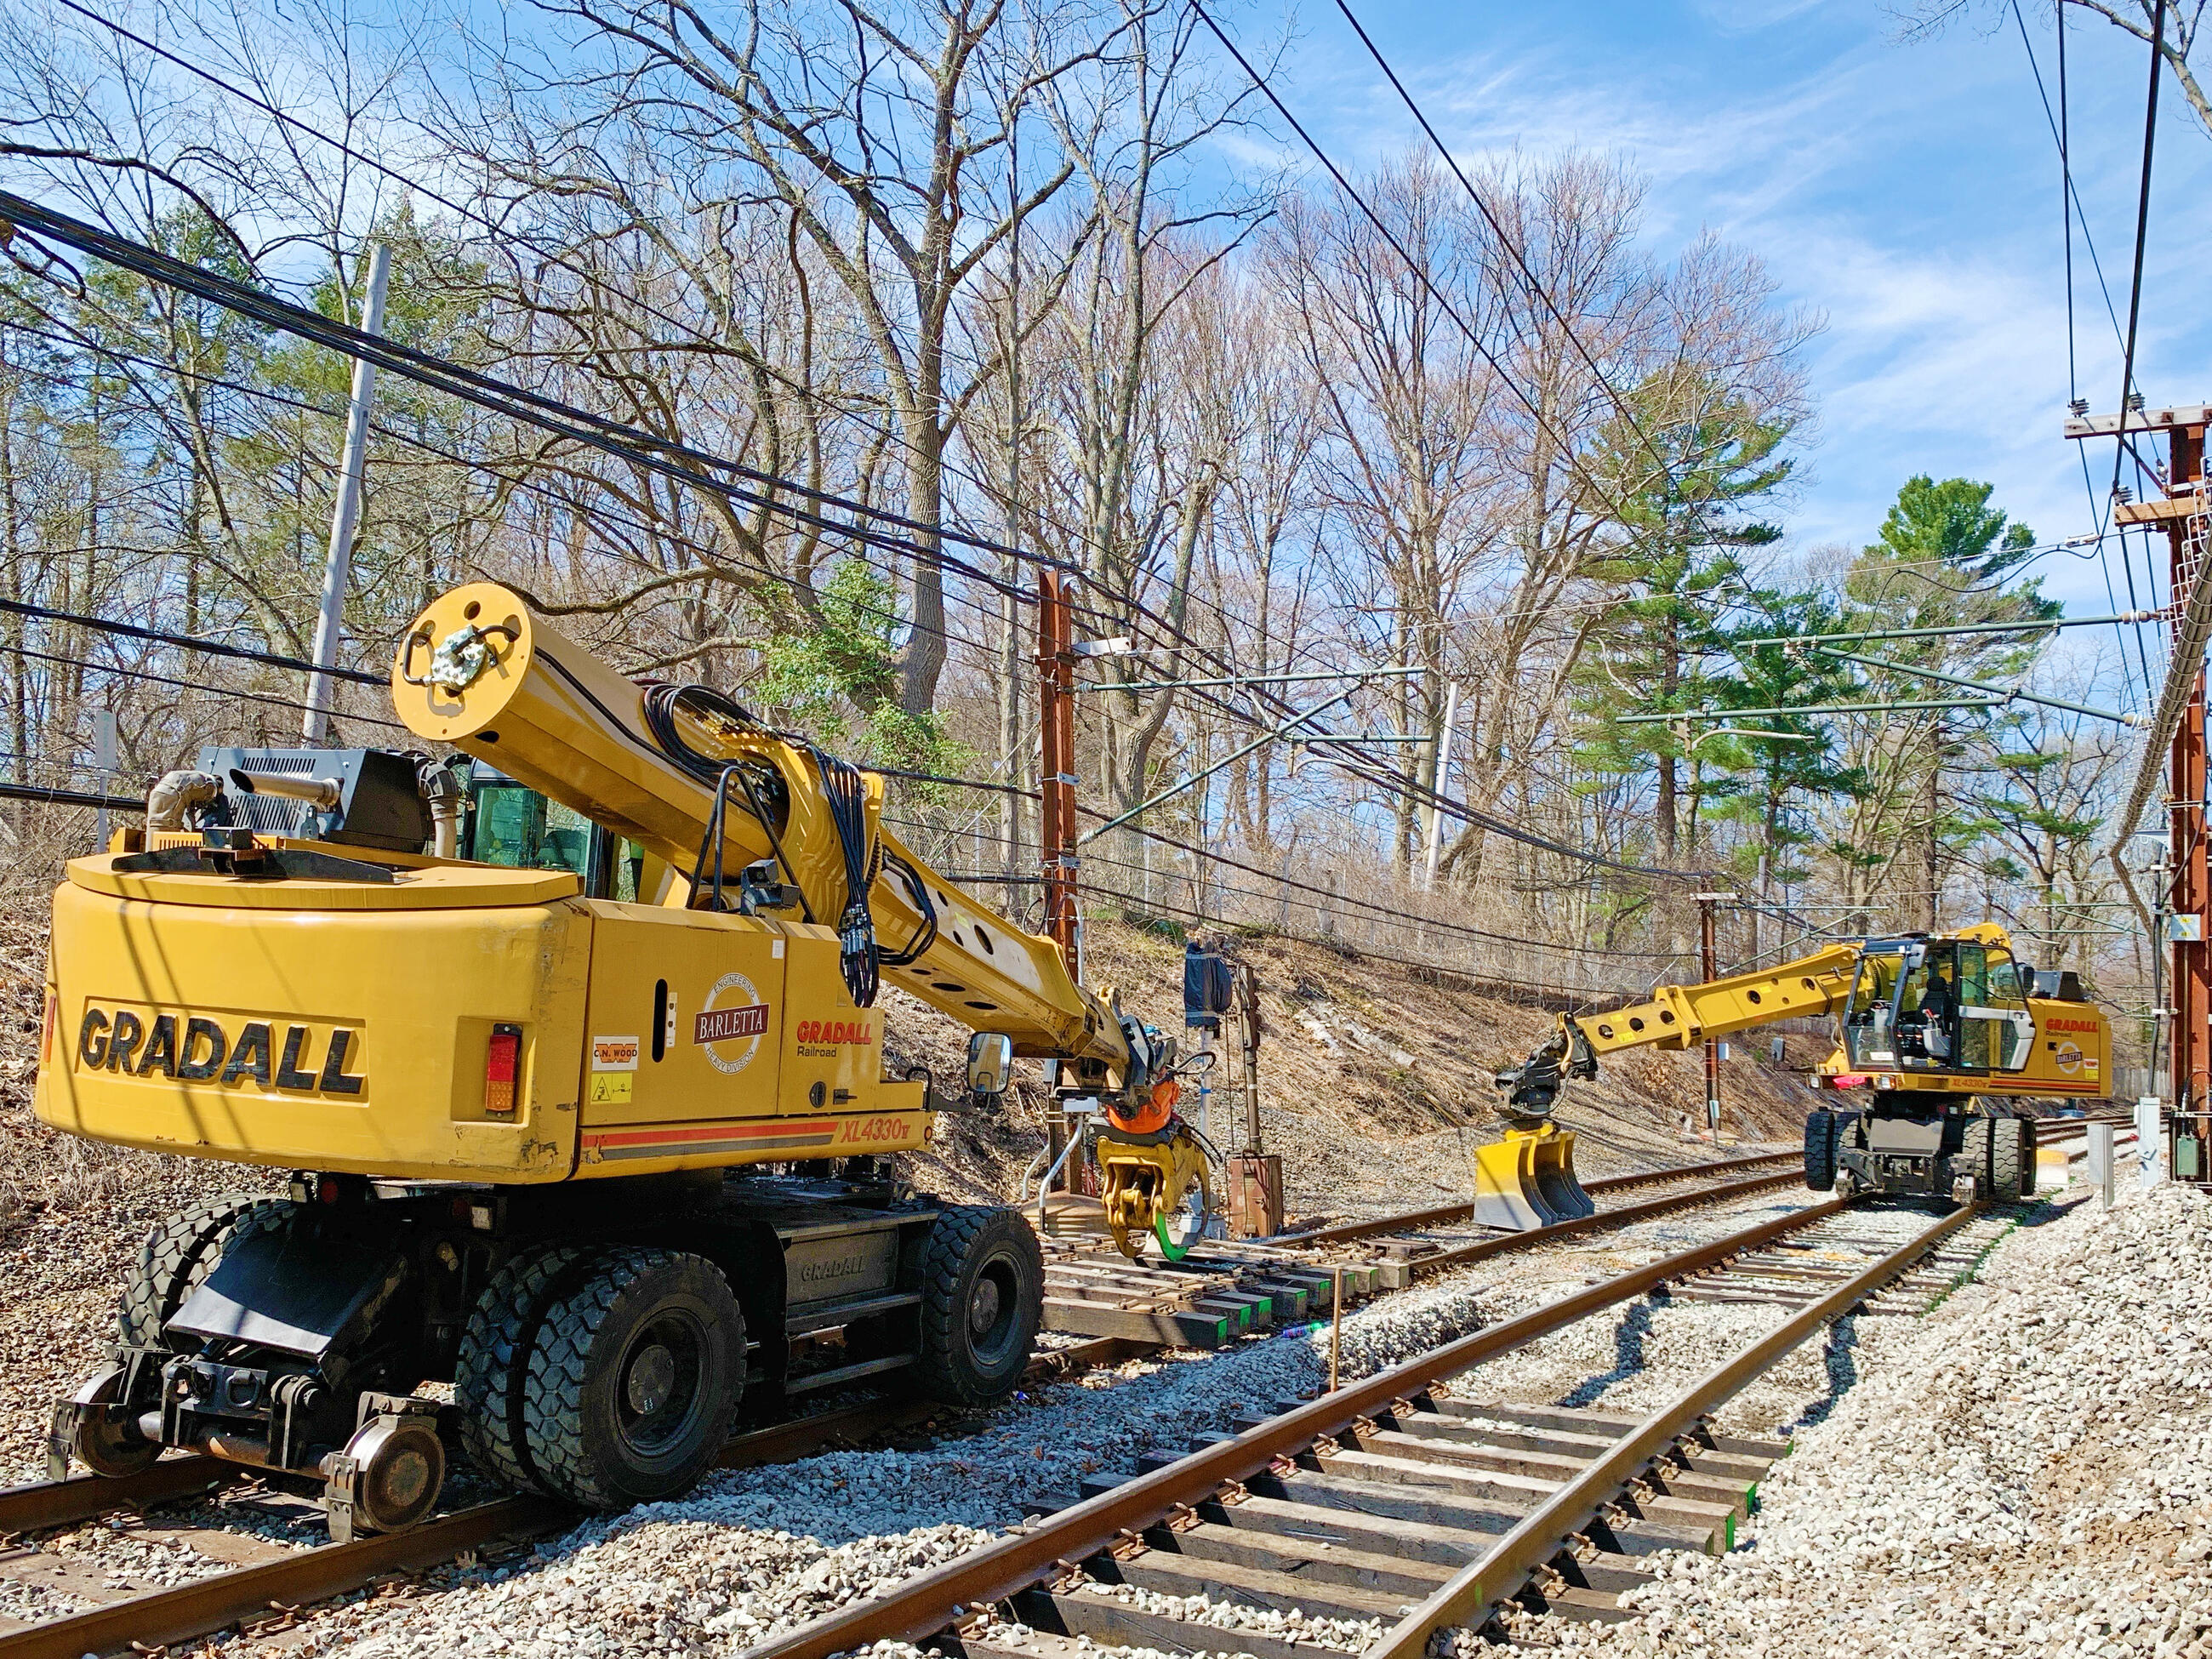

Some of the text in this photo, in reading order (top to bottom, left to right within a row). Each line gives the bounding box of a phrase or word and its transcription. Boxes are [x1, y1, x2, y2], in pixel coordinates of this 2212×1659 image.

[714, 975, 756, 998] ENGINEERING
[699, 1009, 763, 1040] BARLETTA
[796, 1020, 873, 1045] GRADALL
[2046, 1018, 2098, 1033] GRADALL
[80, 1008, 366, 1096] GRADALL
[706, 1046, 754, 1072] HEAVY DIVISION
[797, 1046, 837, 1058] Railroad
[801, 1256, 864, 1282] GRADALL
